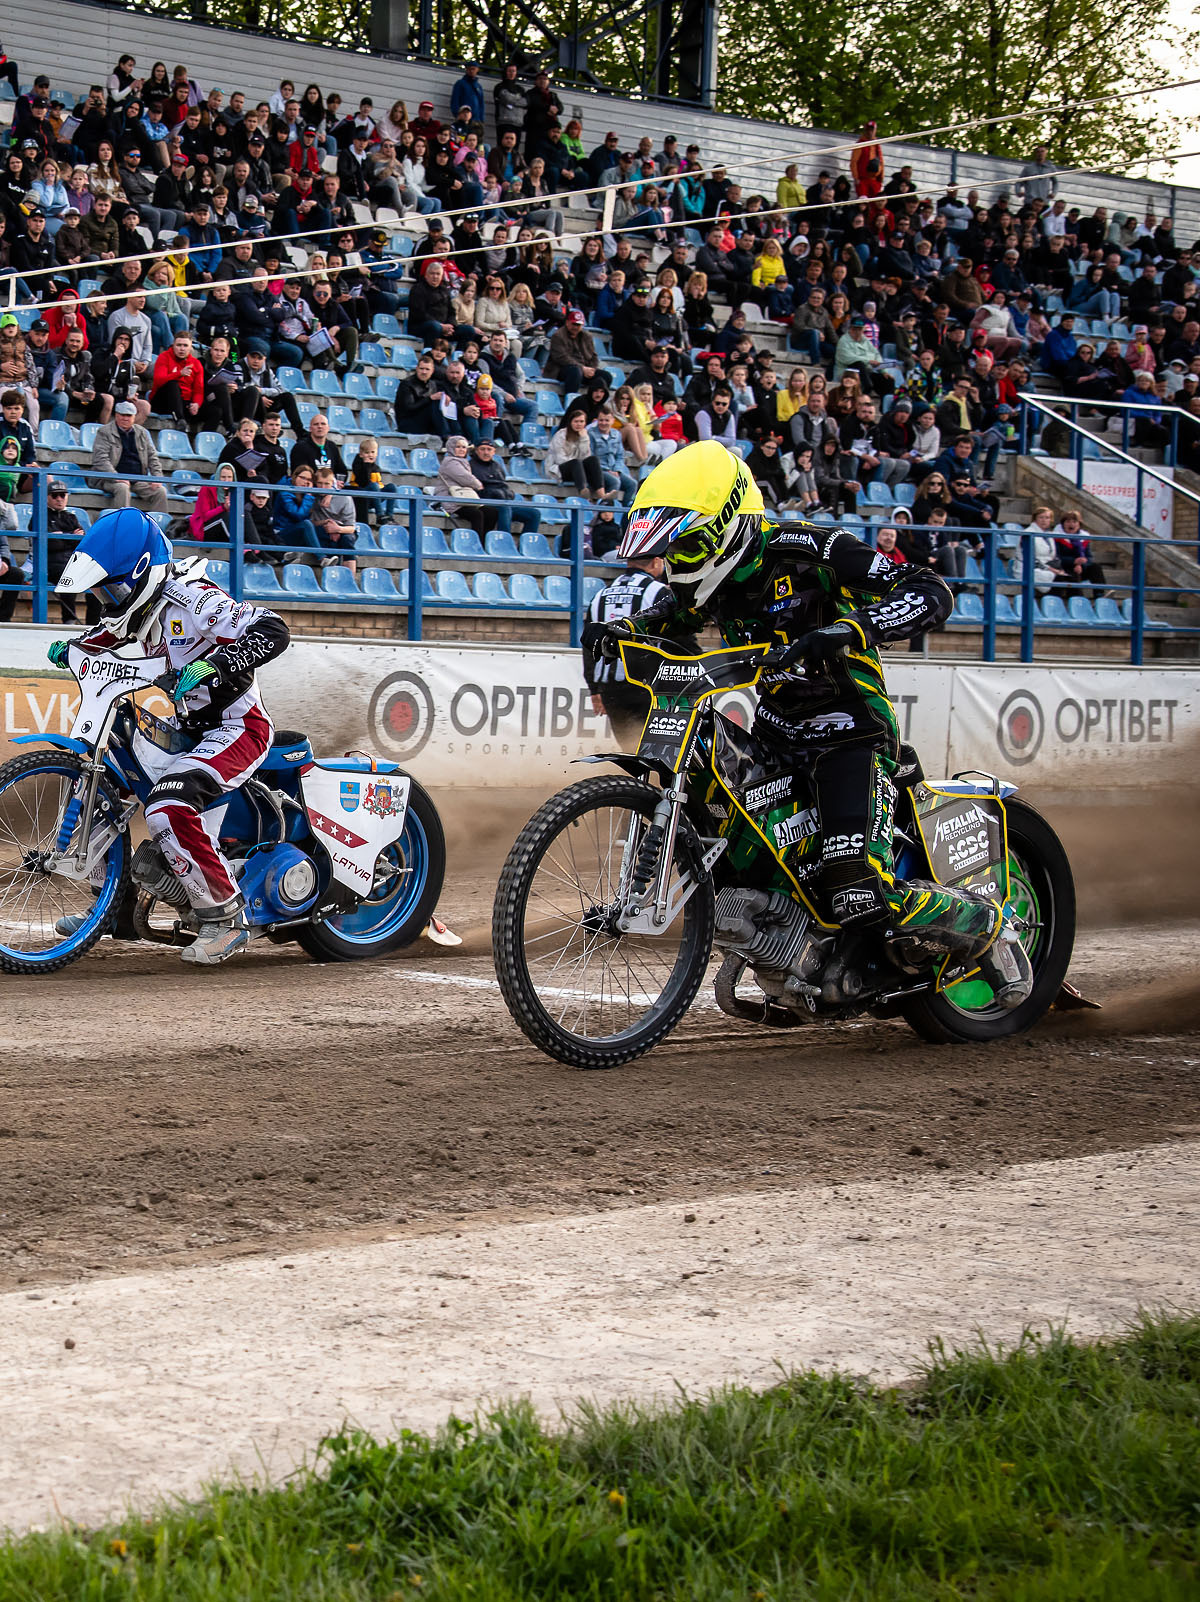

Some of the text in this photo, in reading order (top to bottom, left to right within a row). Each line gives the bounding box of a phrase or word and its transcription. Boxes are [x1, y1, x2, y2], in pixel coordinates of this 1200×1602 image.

[712, 472, 748, 533] 100%
[769, 532, 818, 551] METALIKA
[166, 583, 192, 605] Interio
[868, 592, 925, 625] ACDC
[92, 660, 140, 681] OPTIBET
[236, 646, 268, 671] BEAR
[651, 659, 717, 688] METALIKA
[451, 683, 614, 739] OPTIBE
[648, 716, 688, 731] ACDC
[1055, 697, 1178, 743] OPTIBET
[447, 743, 543, 756] SPORTA
[766, 775, 793, 796] GROUP
[933, 802, 1000, 854] METALIKA
[945, 820, 981, 842] RECYCLING
[948, 830, 990, 865] ACDC
[332, 852, 372, 882] LATVIA
